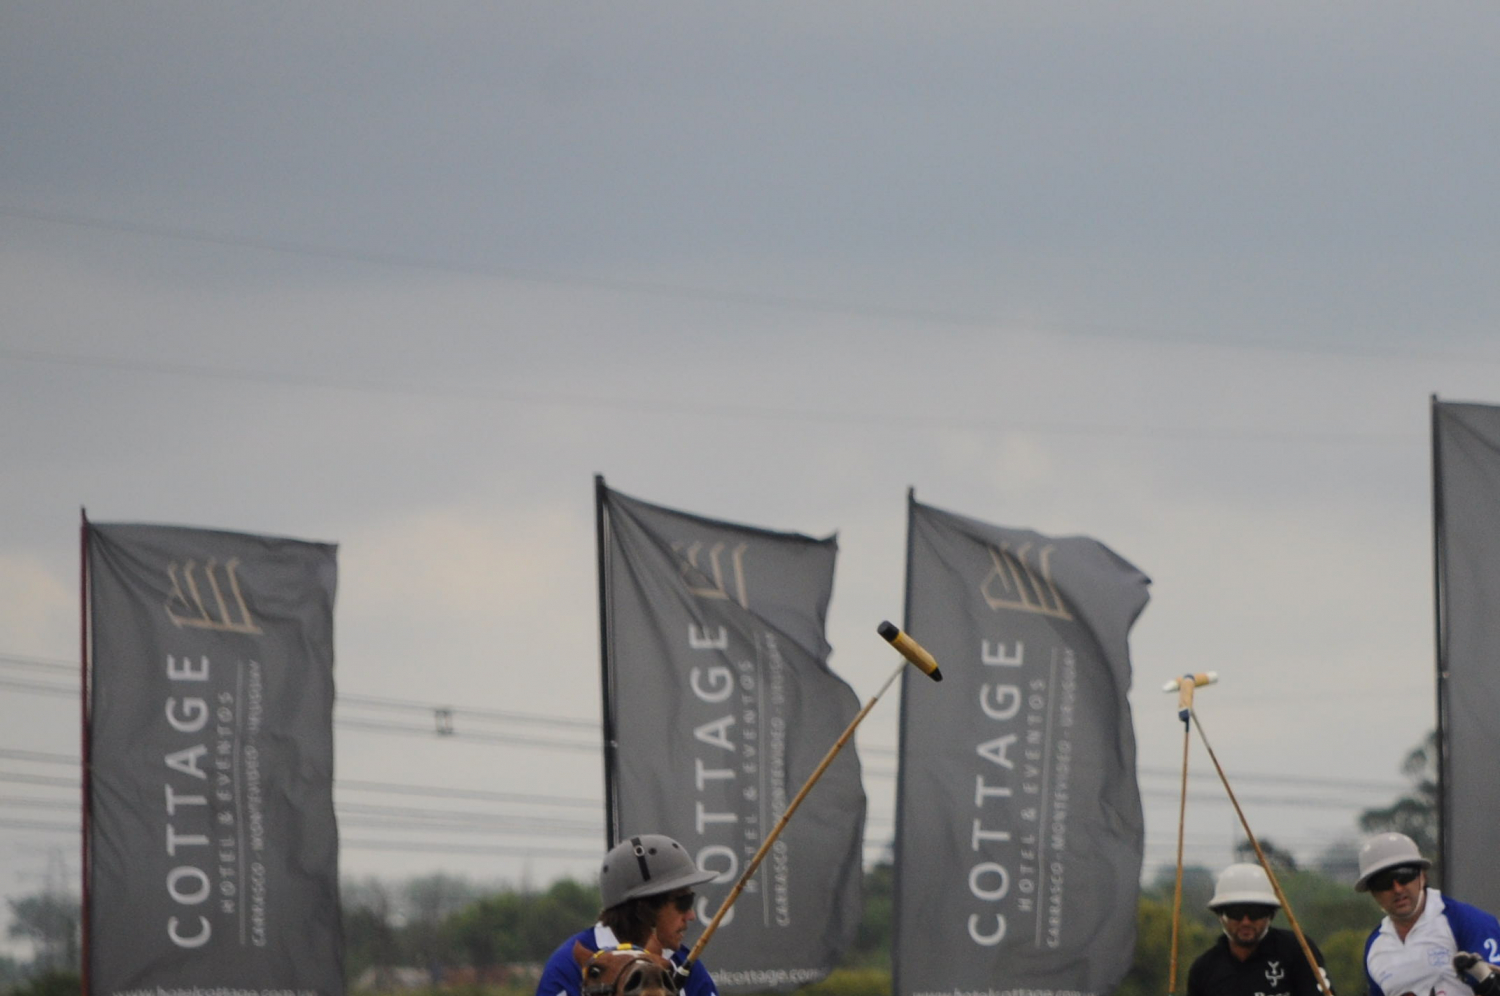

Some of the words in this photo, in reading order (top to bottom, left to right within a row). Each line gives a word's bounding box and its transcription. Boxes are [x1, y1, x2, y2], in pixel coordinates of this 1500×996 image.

[215, 691, 234, 802] EVENTOS
[738, 660, 758, 773] EVENTOS
[1022, 679, 1045, 794] EVENTOS
[165, 654, 213, 948] COTTAGE
[689, 623, 739, 927] COTTAGE
[968, 638, 1024, 947] COTTAGE
[219, 836, 237, 914] HOTEL
[743, 814, 759, 893] HTEL
[1018, 834, 1035, 912] HOTEL
